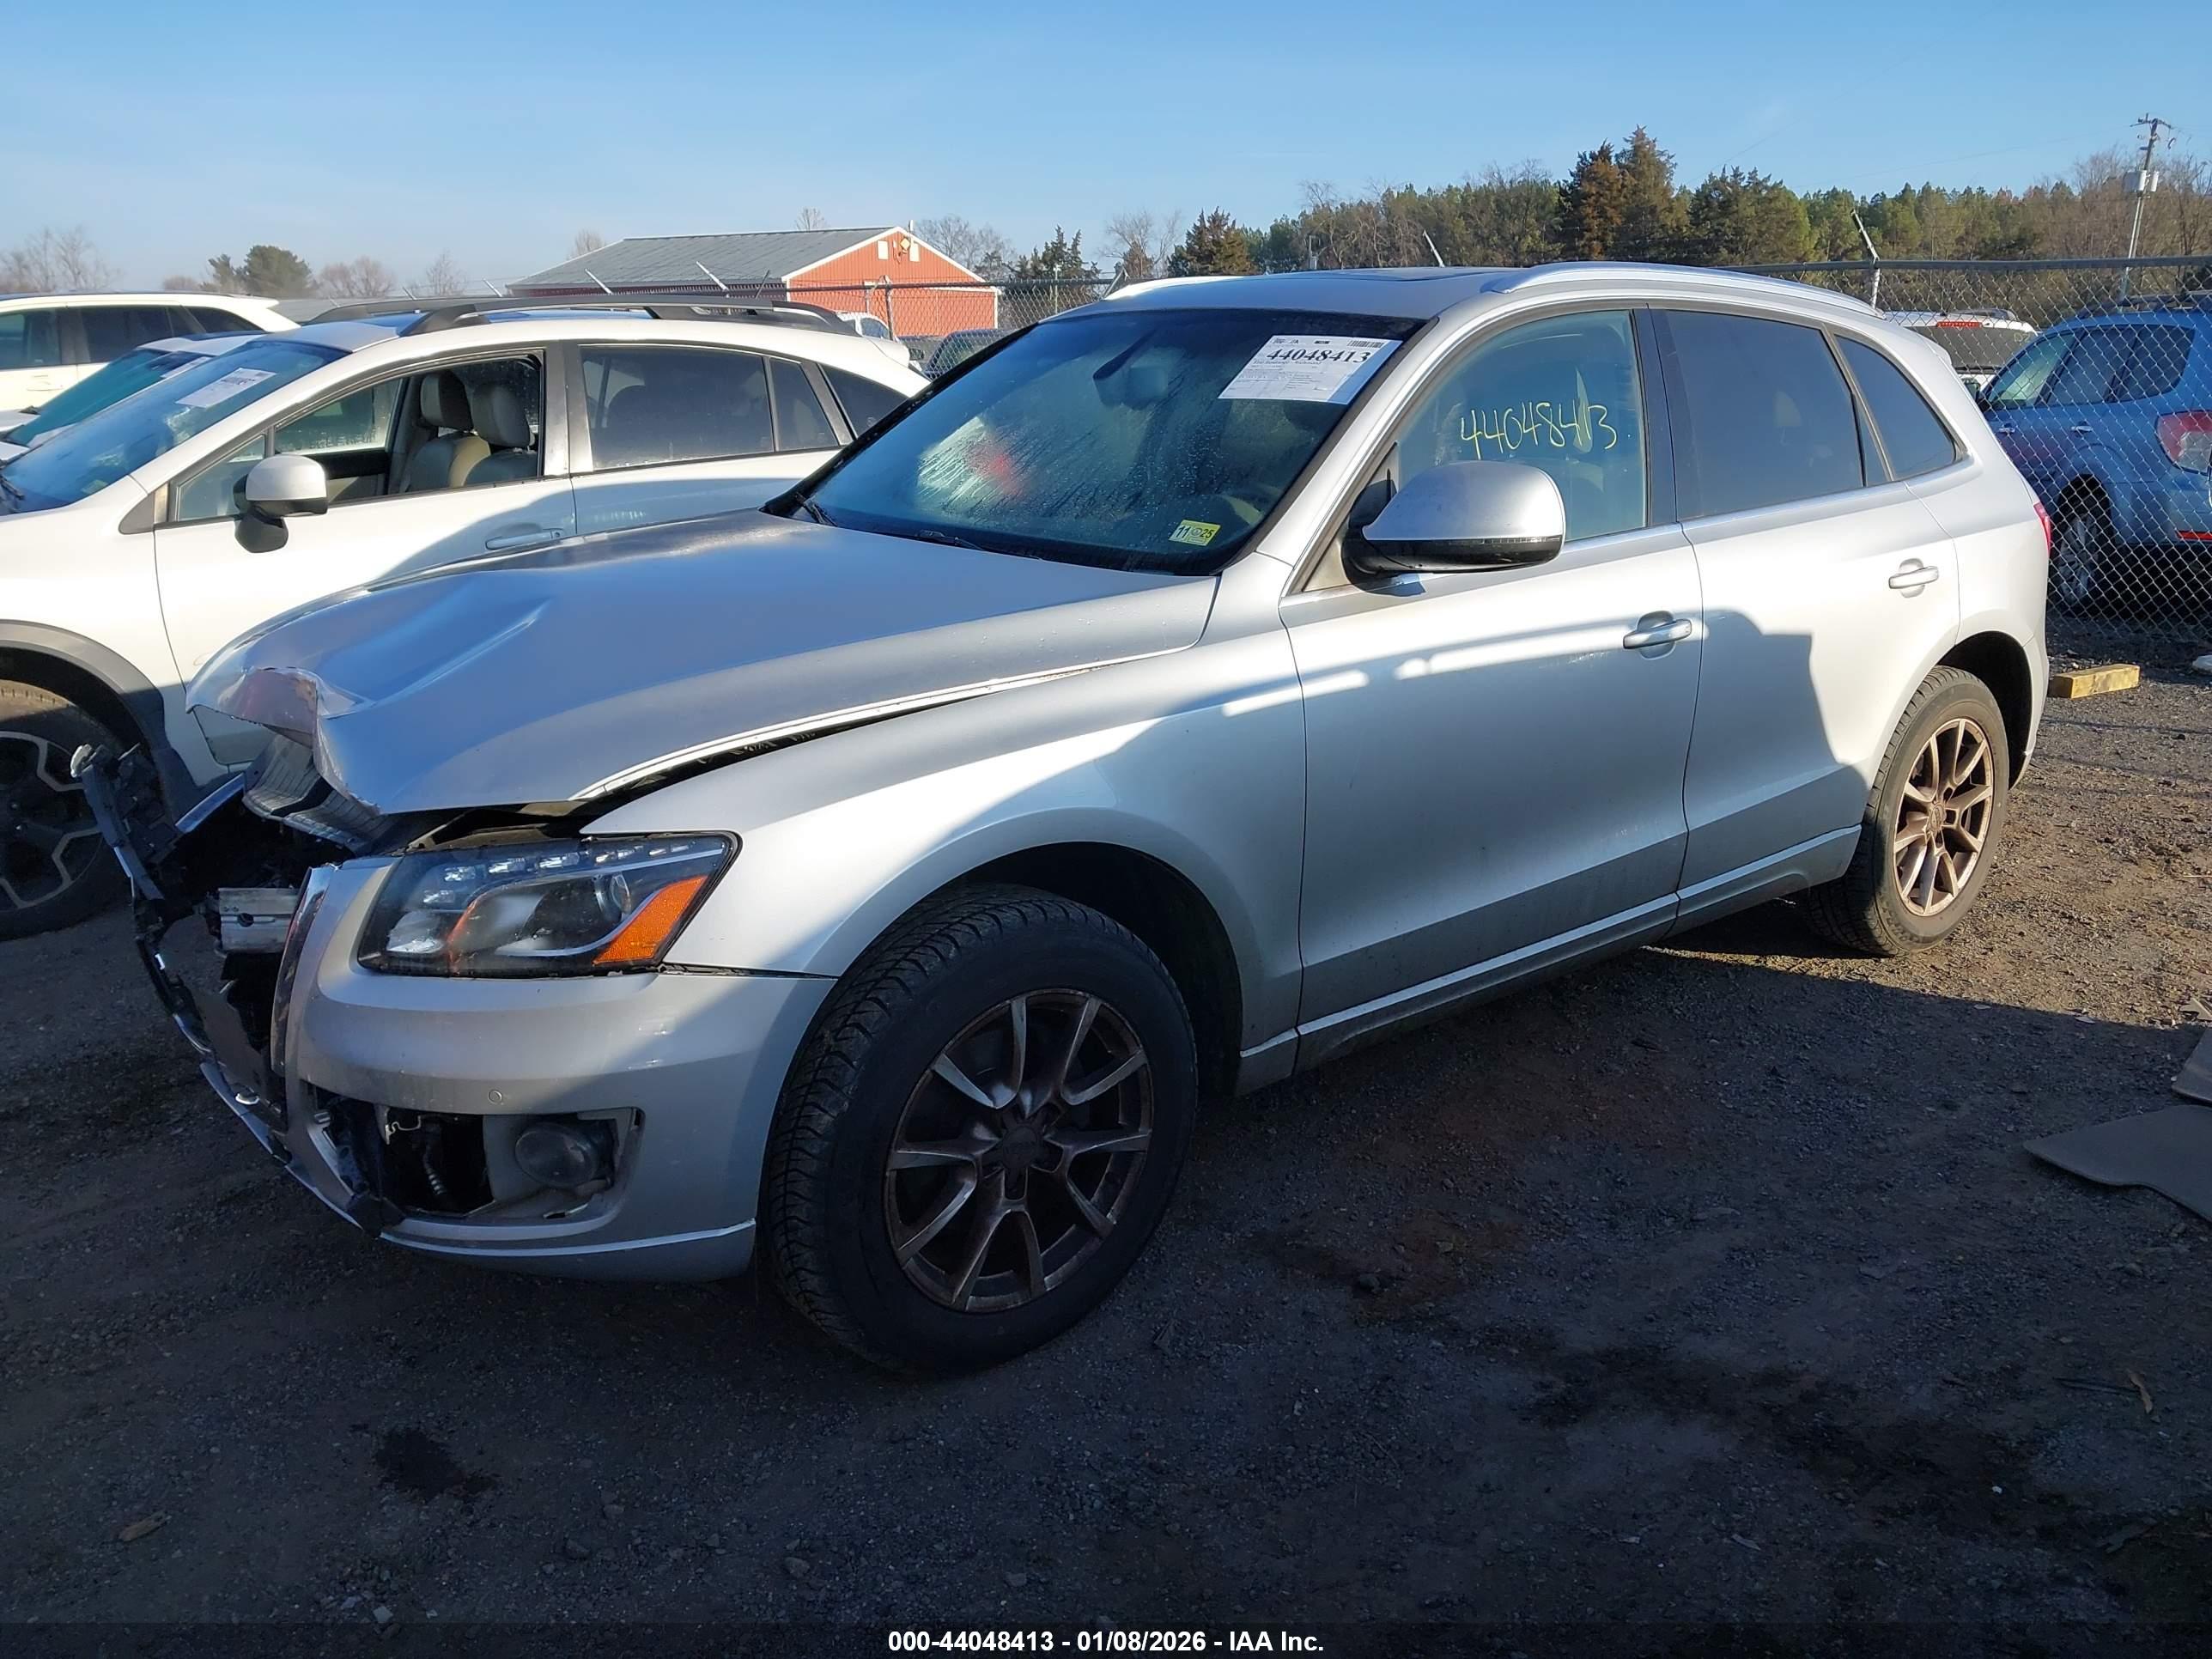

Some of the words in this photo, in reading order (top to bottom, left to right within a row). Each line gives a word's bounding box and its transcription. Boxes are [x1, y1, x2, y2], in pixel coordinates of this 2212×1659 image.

[1266, 349, 1371, 363] 44048413
[1460, 398, 1618, 460] 44048413
[1176, 526, 1192, 538] 11
[1200, 528, 1216, 538] 25
